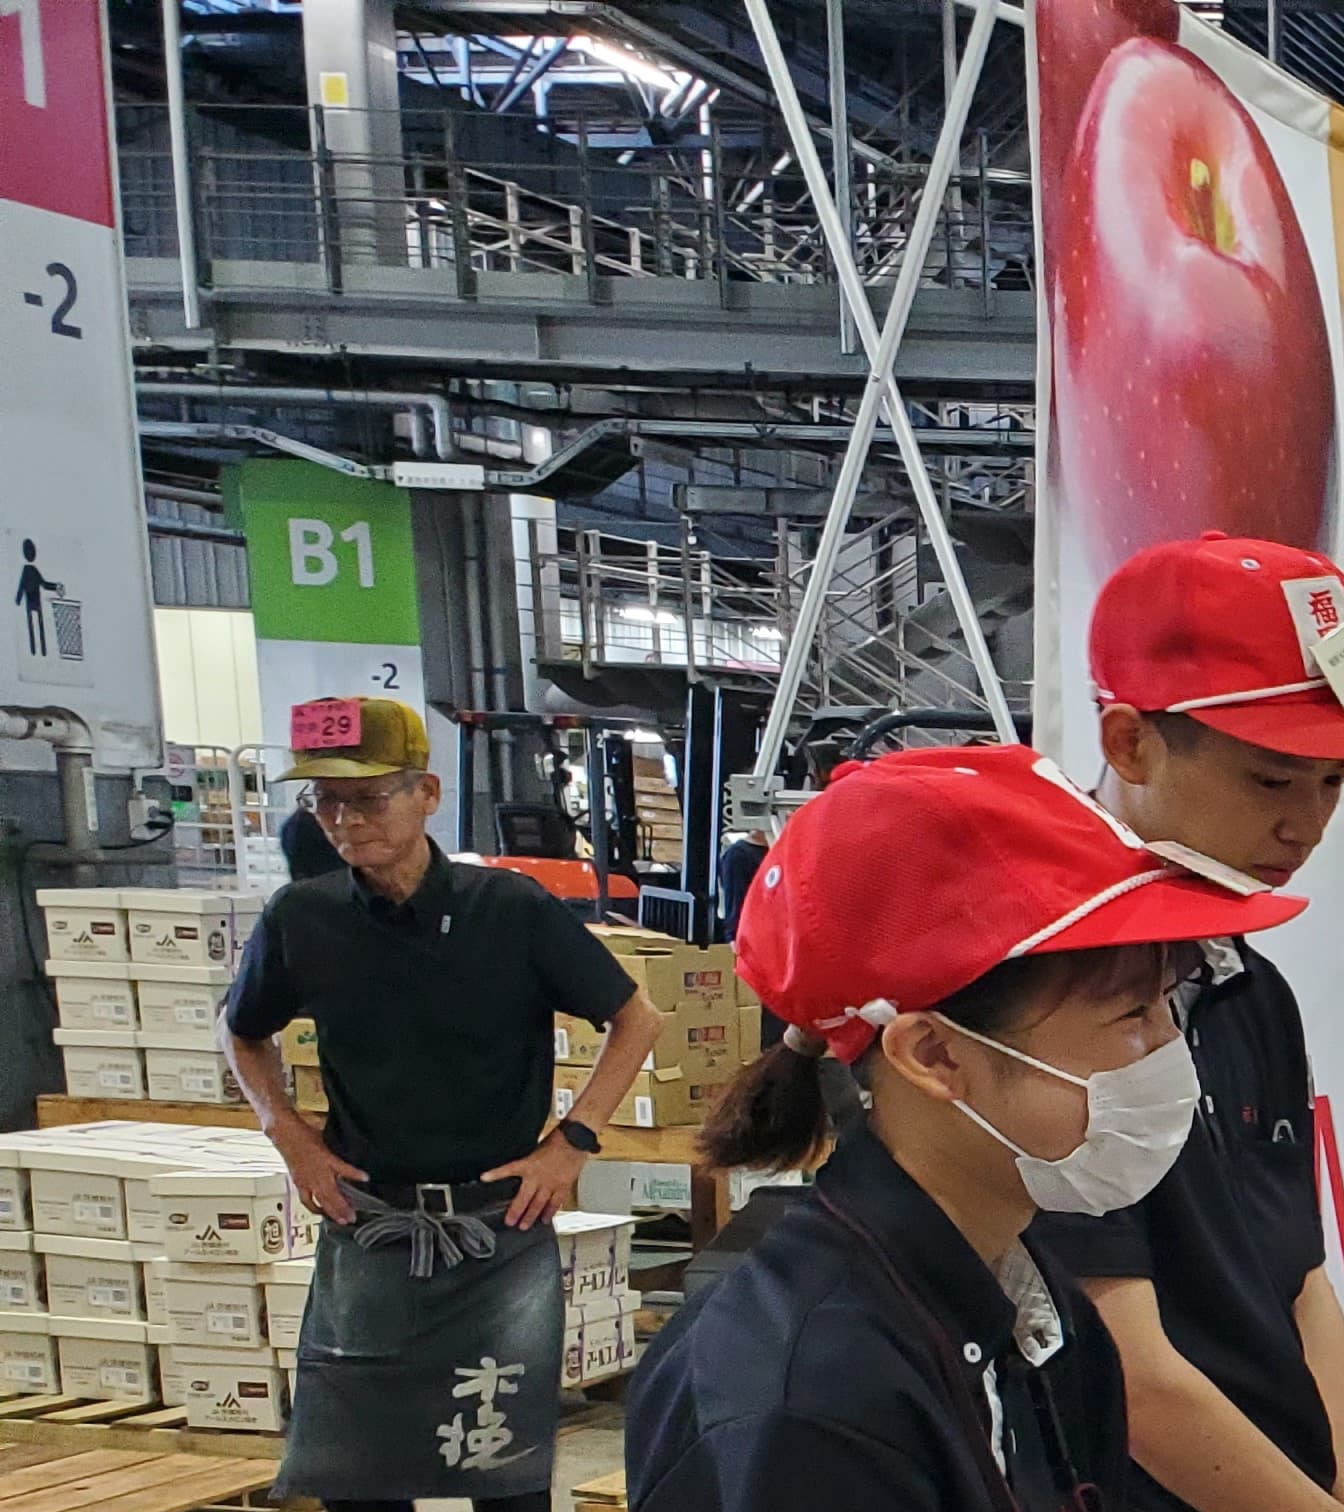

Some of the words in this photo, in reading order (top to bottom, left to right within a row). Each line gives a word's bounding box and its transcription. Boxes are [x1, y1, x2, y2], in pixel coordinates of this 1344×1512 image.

[288, 518, 374, 588] B1
[371, 663, 400, 690] -2
[321, 715, 352, 736] 29
